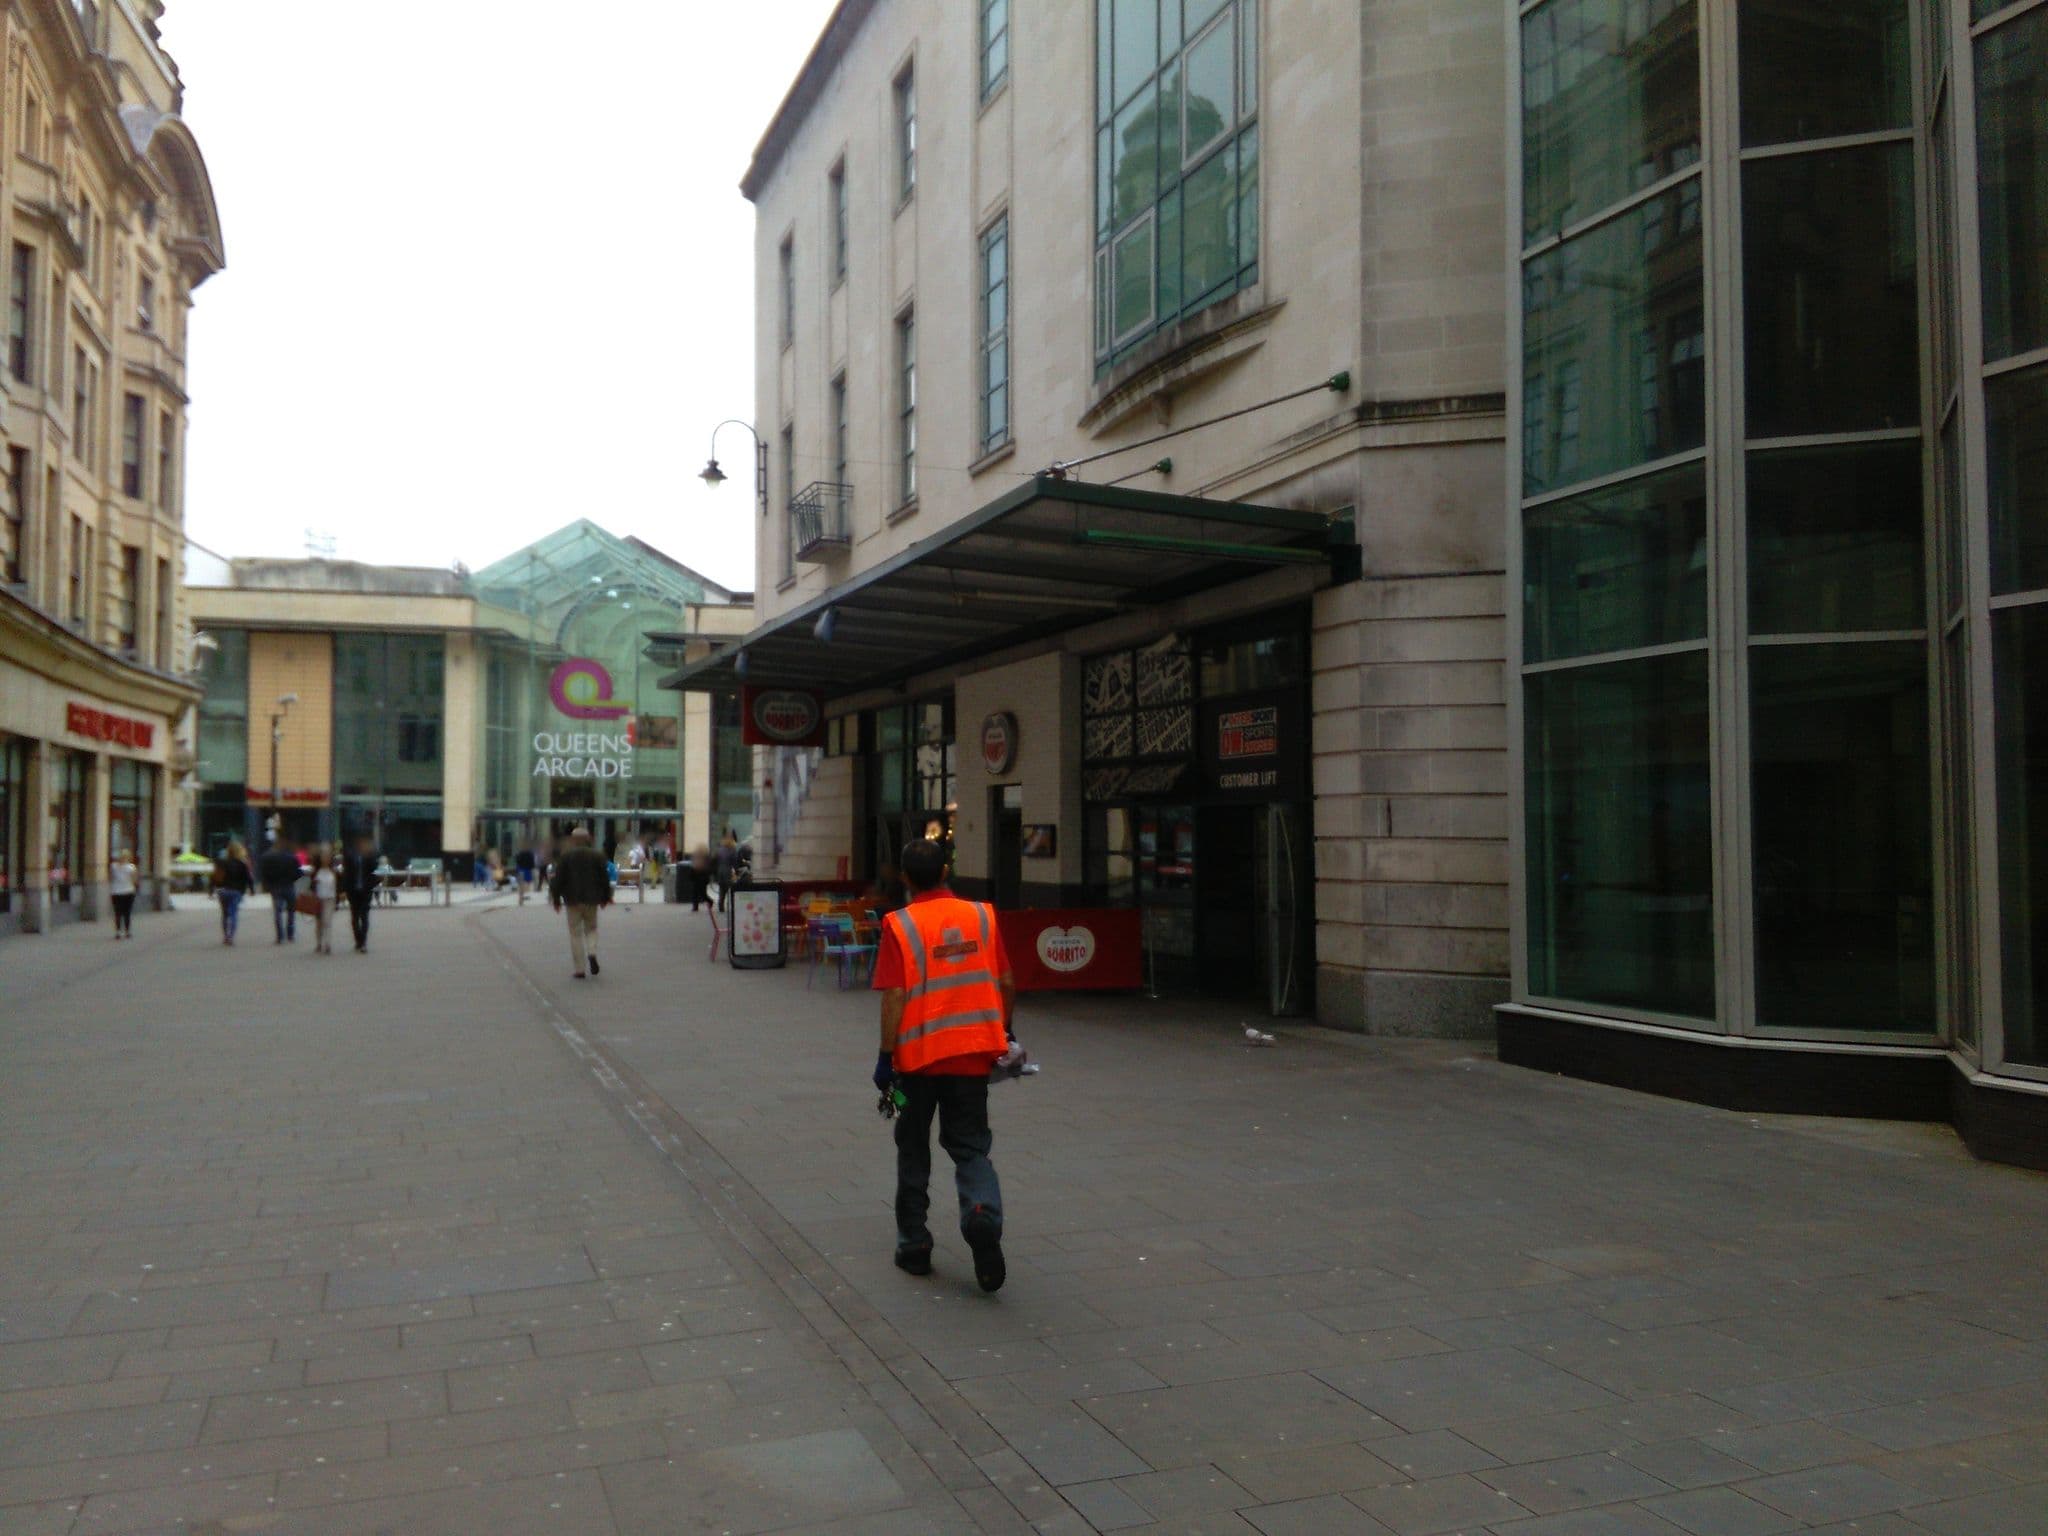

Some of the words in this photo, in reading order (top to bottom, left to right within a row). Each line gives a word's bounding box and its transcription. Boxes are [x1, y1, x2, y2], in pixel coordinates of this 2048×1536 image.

[1244, 726, 1274, 739] SPORTS
[533, 732, 633, 755] QUEENS
[533, 757, 633, 778] ARCADE
[1219, 773, 1259, 788] CUSTOMER
[1261, 770, 1277, 785] LIFT
[1046, 946, 1086, 963] BURRITO
